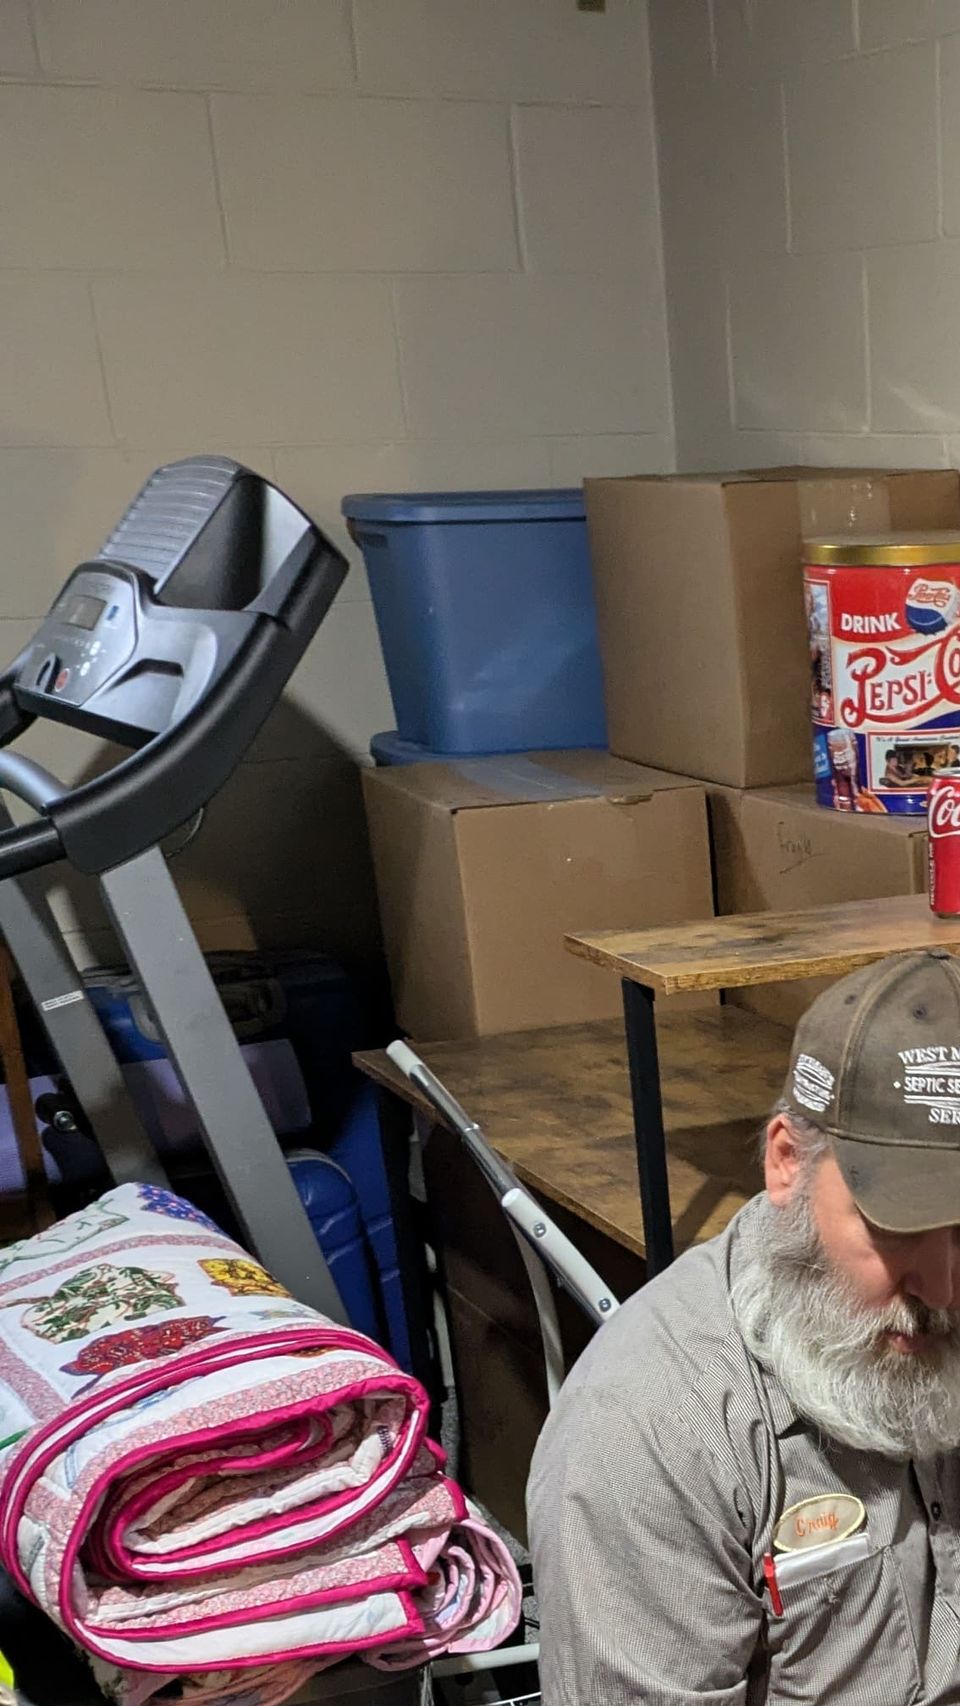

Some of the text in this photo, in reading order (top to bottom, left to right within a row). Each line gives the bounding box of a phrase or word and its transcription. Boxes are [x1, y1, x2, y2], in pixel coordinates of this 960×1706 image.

[841, 613, 901, 634] DRINK
[898, 1046, 948, 1064] WEST
[904, 1077, 945, 1092] SEPTIC
[795, 1512, 839, 1537] Craig
